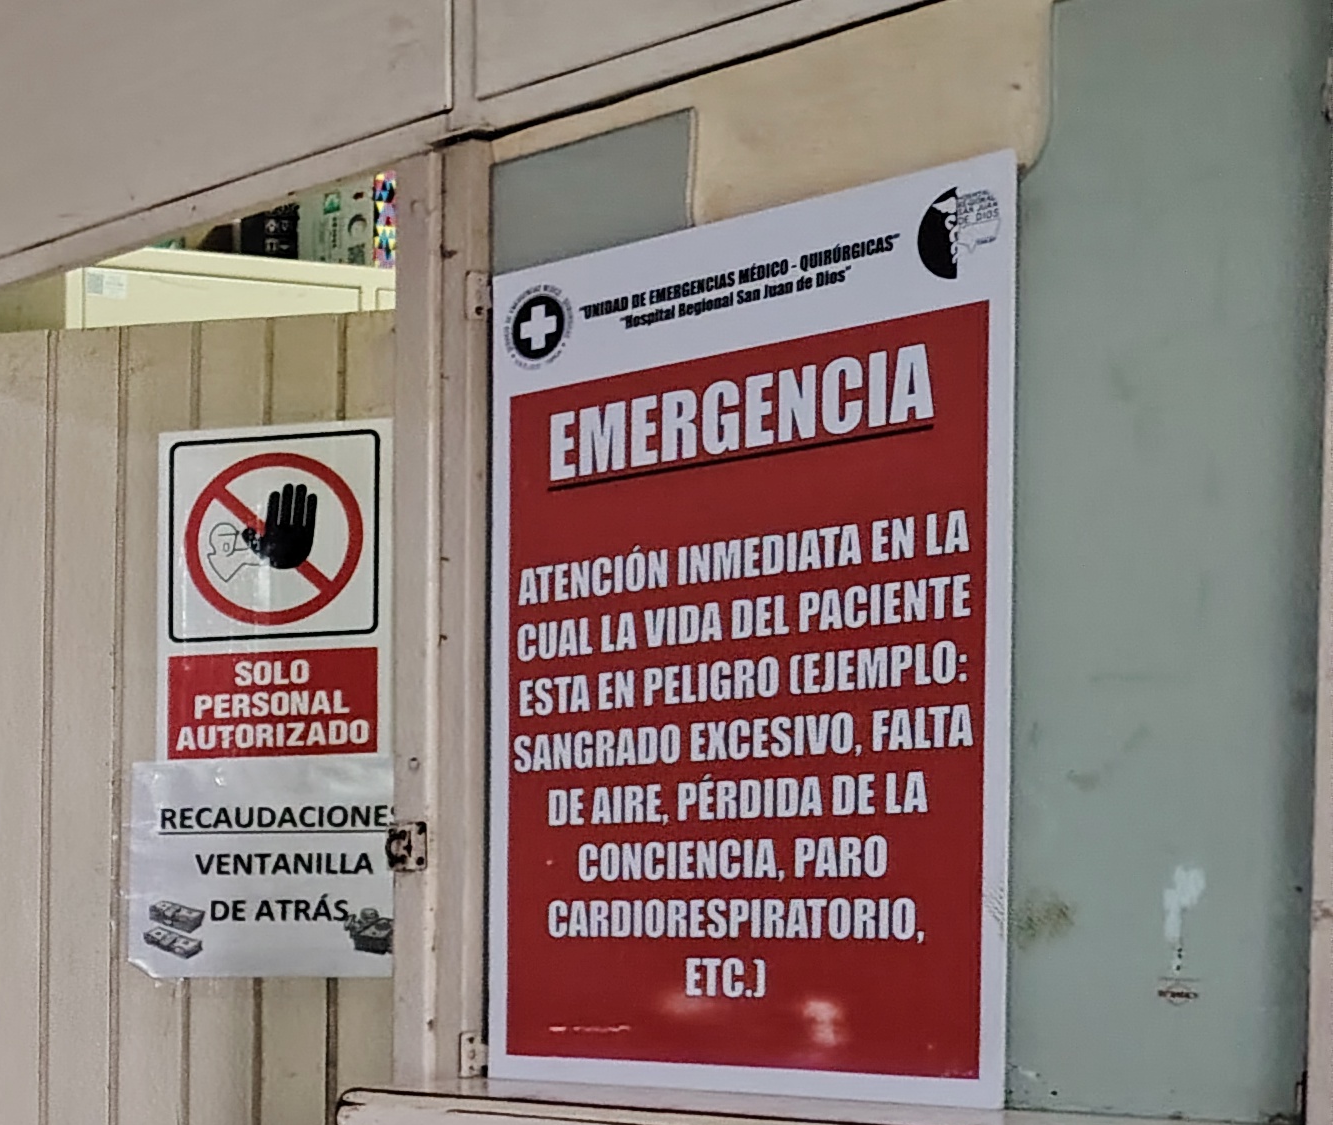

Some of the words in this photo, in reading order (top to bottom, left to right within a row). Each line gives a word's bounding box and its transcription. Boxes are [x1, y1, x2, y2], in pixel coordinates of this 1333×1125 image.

[632, 292, 646, 310] DE
[649, 271, 736, 305] EMERGENCIAS
[739, 258, 789, 286] MÉDICO
[678, 291, 733, 318] Regional
[737, 288, 760, 305] San
[763, 281, 793, 300] Juan
[796, 275, 813, 292] de
[548, 343, 934, 482] EMERGENCIA
[518, 545, 668, 606] ATENCIÓN
[678, 524, 862, 586] INMEDIATA
[871, 516, 915, 562] EN
[926, 509, 970, 556] LA
[517, 617, 593, 662] CUAL
[600, 611, 637, 653] LA
[644, 602, 722, 648] VIDA
[731, 595, 790, 640] DEL
[799, 573, 971, 633] PACIENTE
[234, 658, 310, 687] SOLO
[519, 674, 590, 717] ESTA
[598, 669, 635, 711] EN
[644, 656, 779, 707] PELIGRO
[789, 640, 968, 695] (EJEMPLO:
[194, 689, 350, 720] PERSONAL
[176, 718, 370, 751] AUTORIZADO
[513, 724, 680, 774] SANGRADO
[690, 711, 863, 764] EXCESIVO,
[871, 703, 973, 754] FALTA
[548, 787, 584, 827] DE
[591, 784, 669, 827] AIRE,
[677, 772, 822, 821] PÉRDIDA
[832, 773, 876, 817] DE
[885, 771, 929, 815] LA
[195, 852, 374, 876] VENTANILLA
[578, 838, 786, 883] CONCIENCIA,
[794, 834, 888, 879] PARO
[210, 899, 246, 922] DE
[255, 893, 350, 923] ATRÁS
[547, 897, 925, 944] CARDIORESPIRATORIO,
[684, 957, 766, 998] ETC.)
